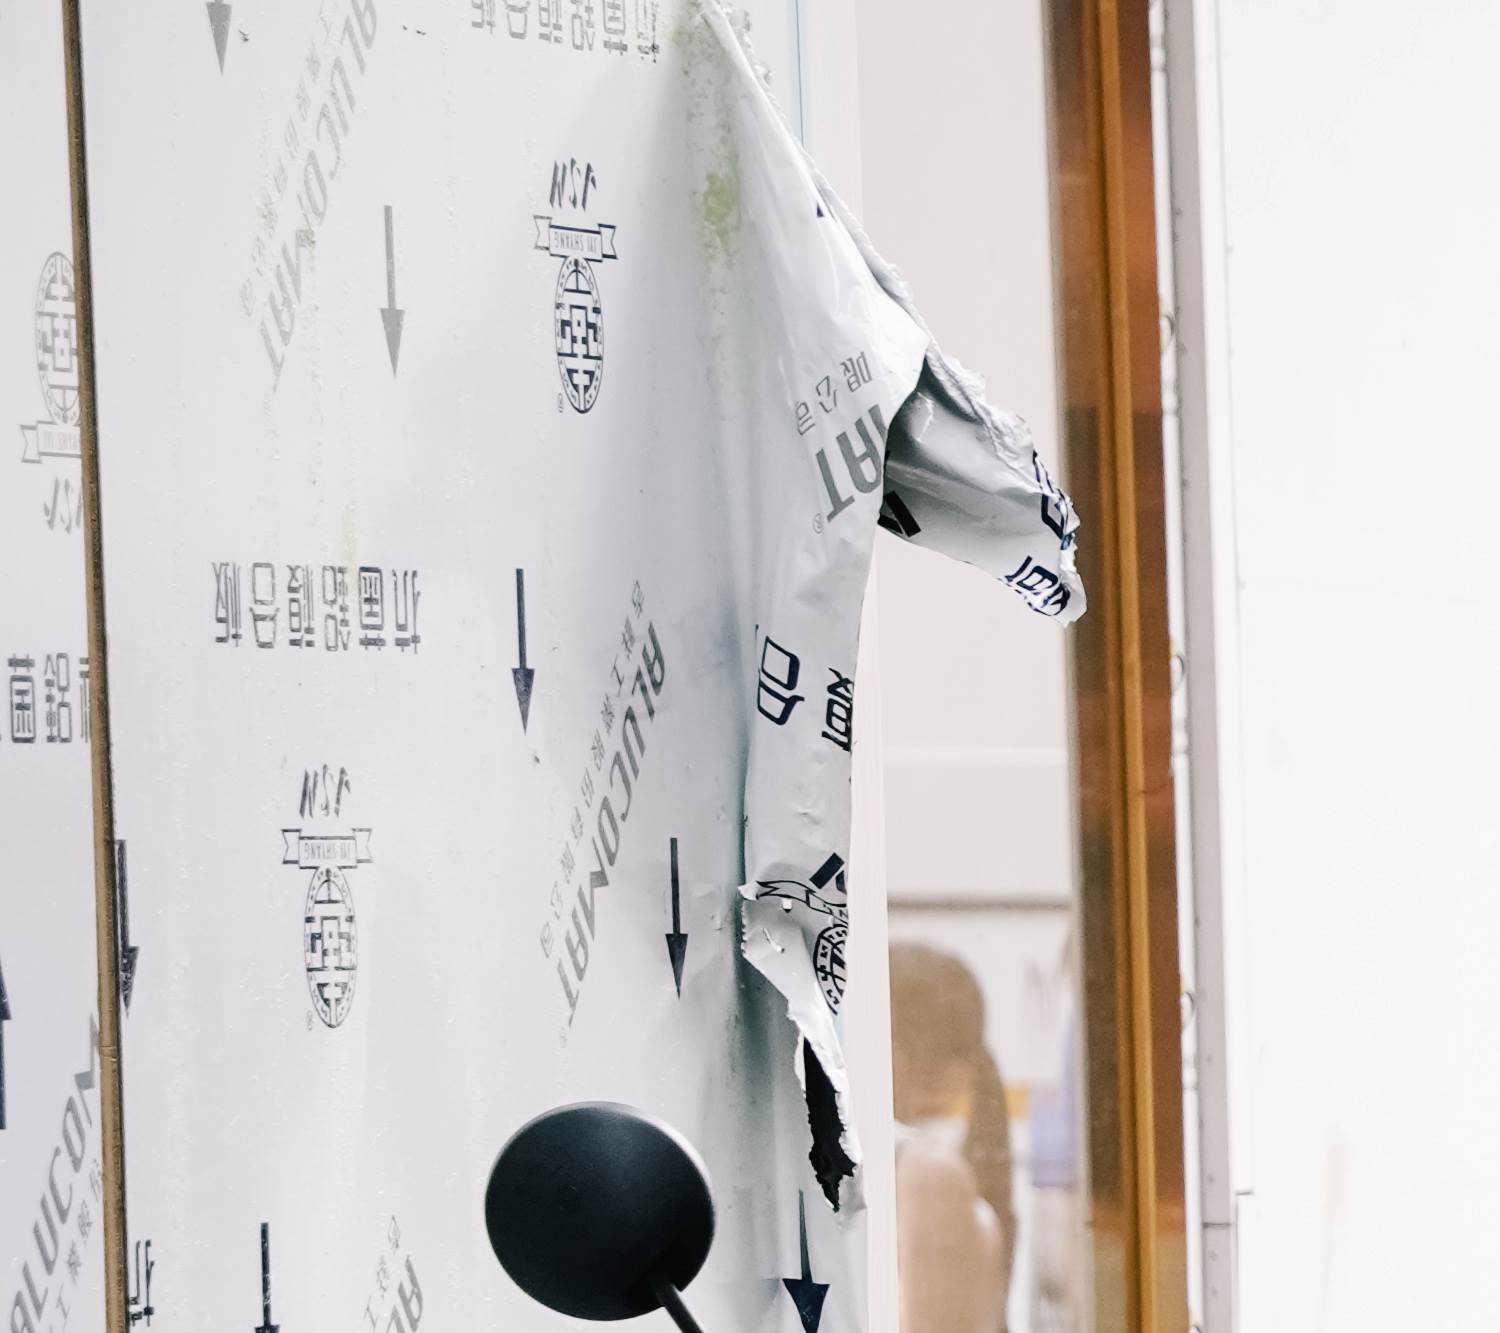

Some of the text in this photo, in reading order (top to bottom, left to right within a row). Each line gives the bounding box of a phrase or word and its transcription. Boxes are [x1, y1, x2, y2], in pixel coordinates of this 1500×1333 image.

[211, 562, 421, 655] 抗菌鋁複合板
[558, 619, 668, 1026] ALUCOMAT
